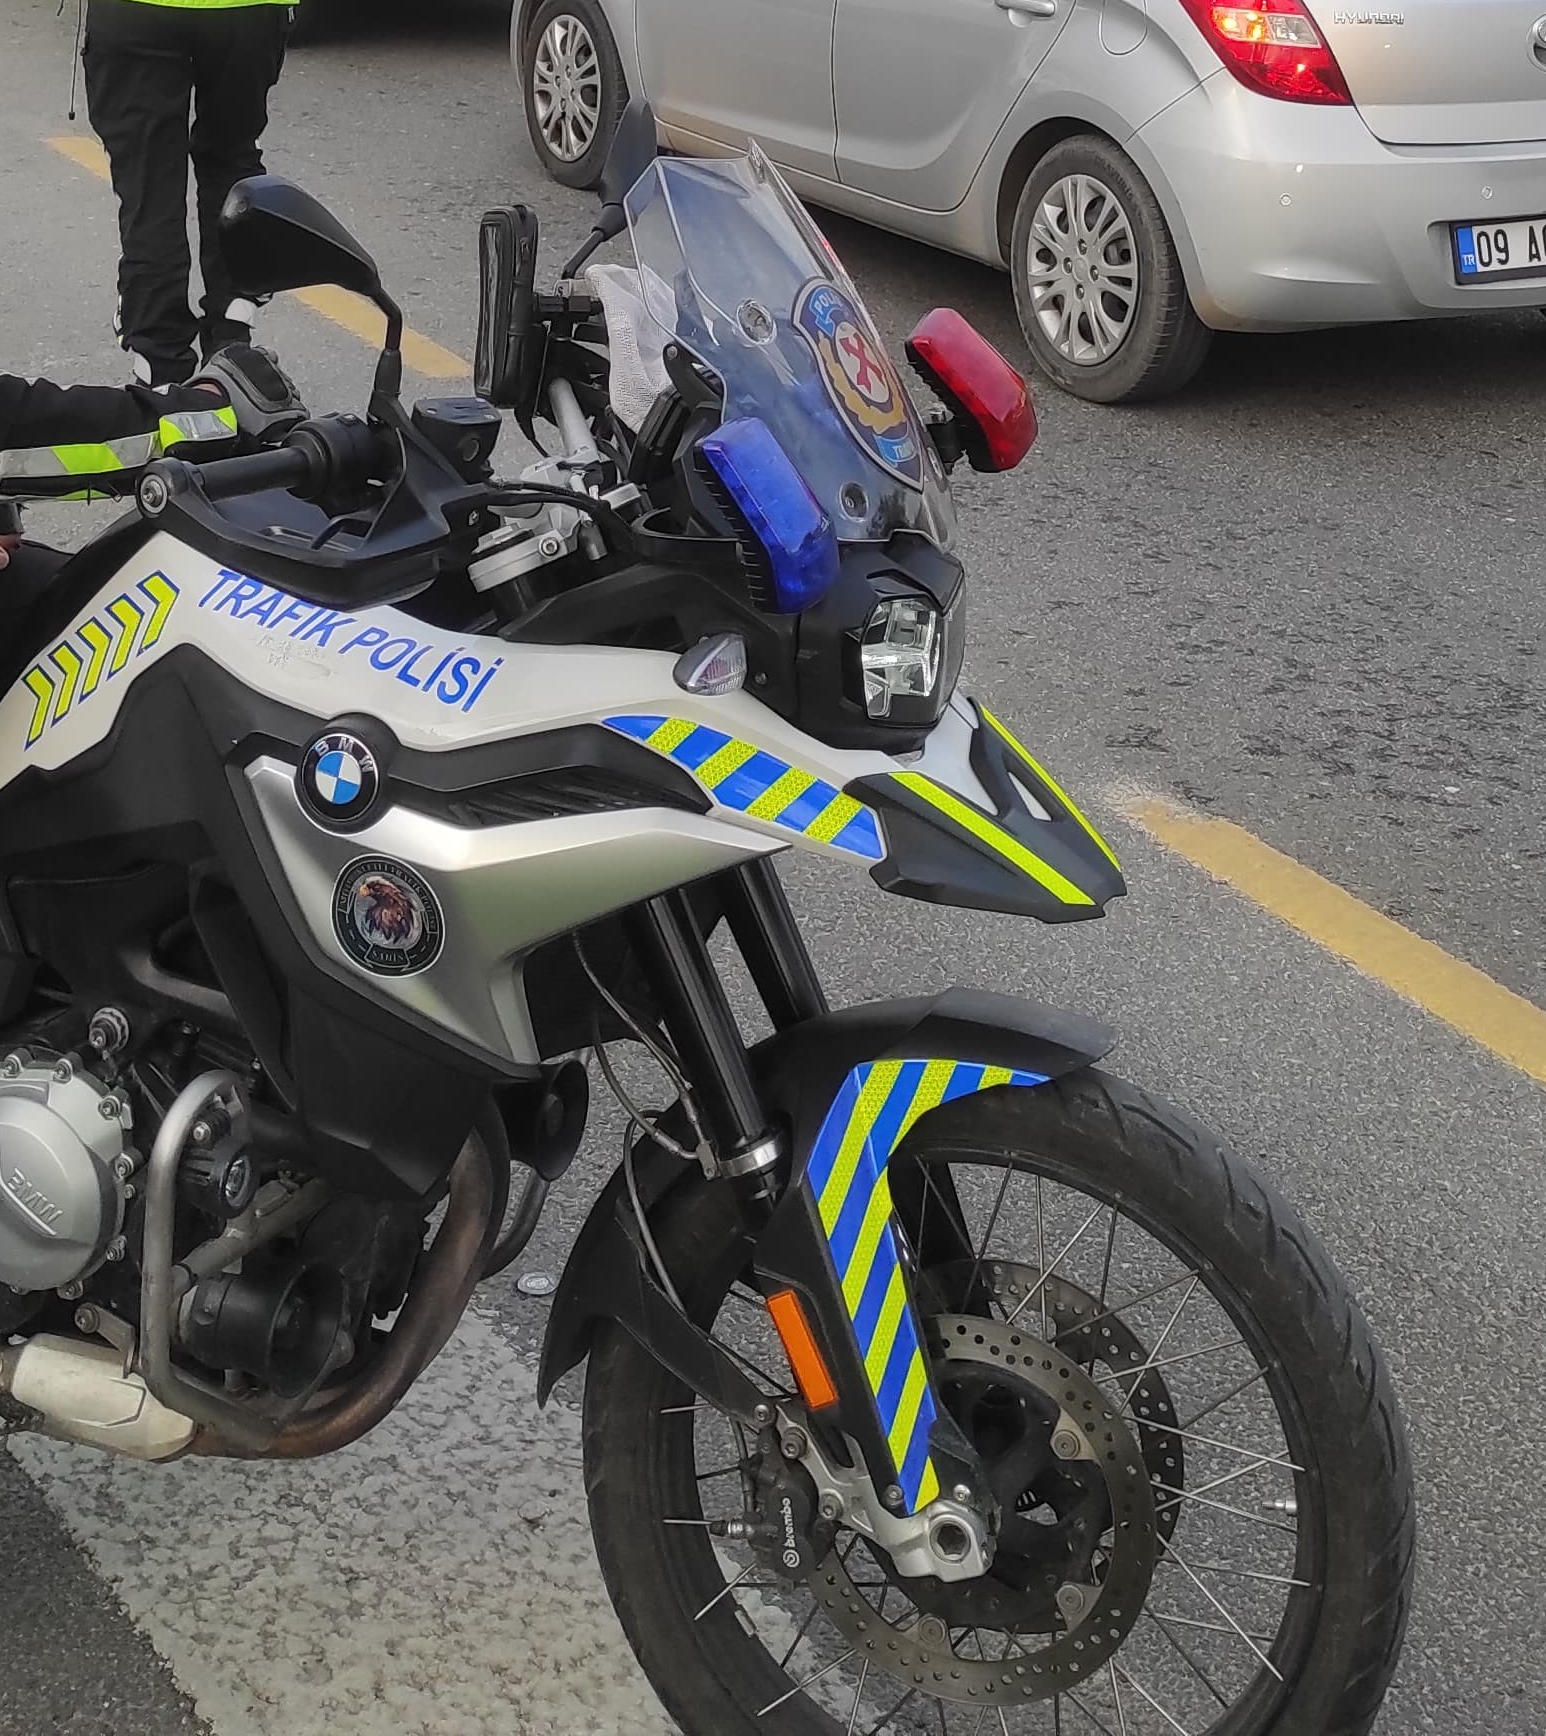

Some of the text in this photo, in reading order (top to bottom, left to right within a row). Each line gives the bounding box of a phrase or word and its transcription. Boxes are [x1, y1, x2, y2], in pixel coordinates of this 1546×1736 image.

[1334, 11, 1405, 25] HYUNDAI
[1476, 228, 1510, 268] 09
[317, 737, 374, 773] BMW
[7, 1167, 64, 1225] BMW
[778, 1497, 796, 1548] brembo
